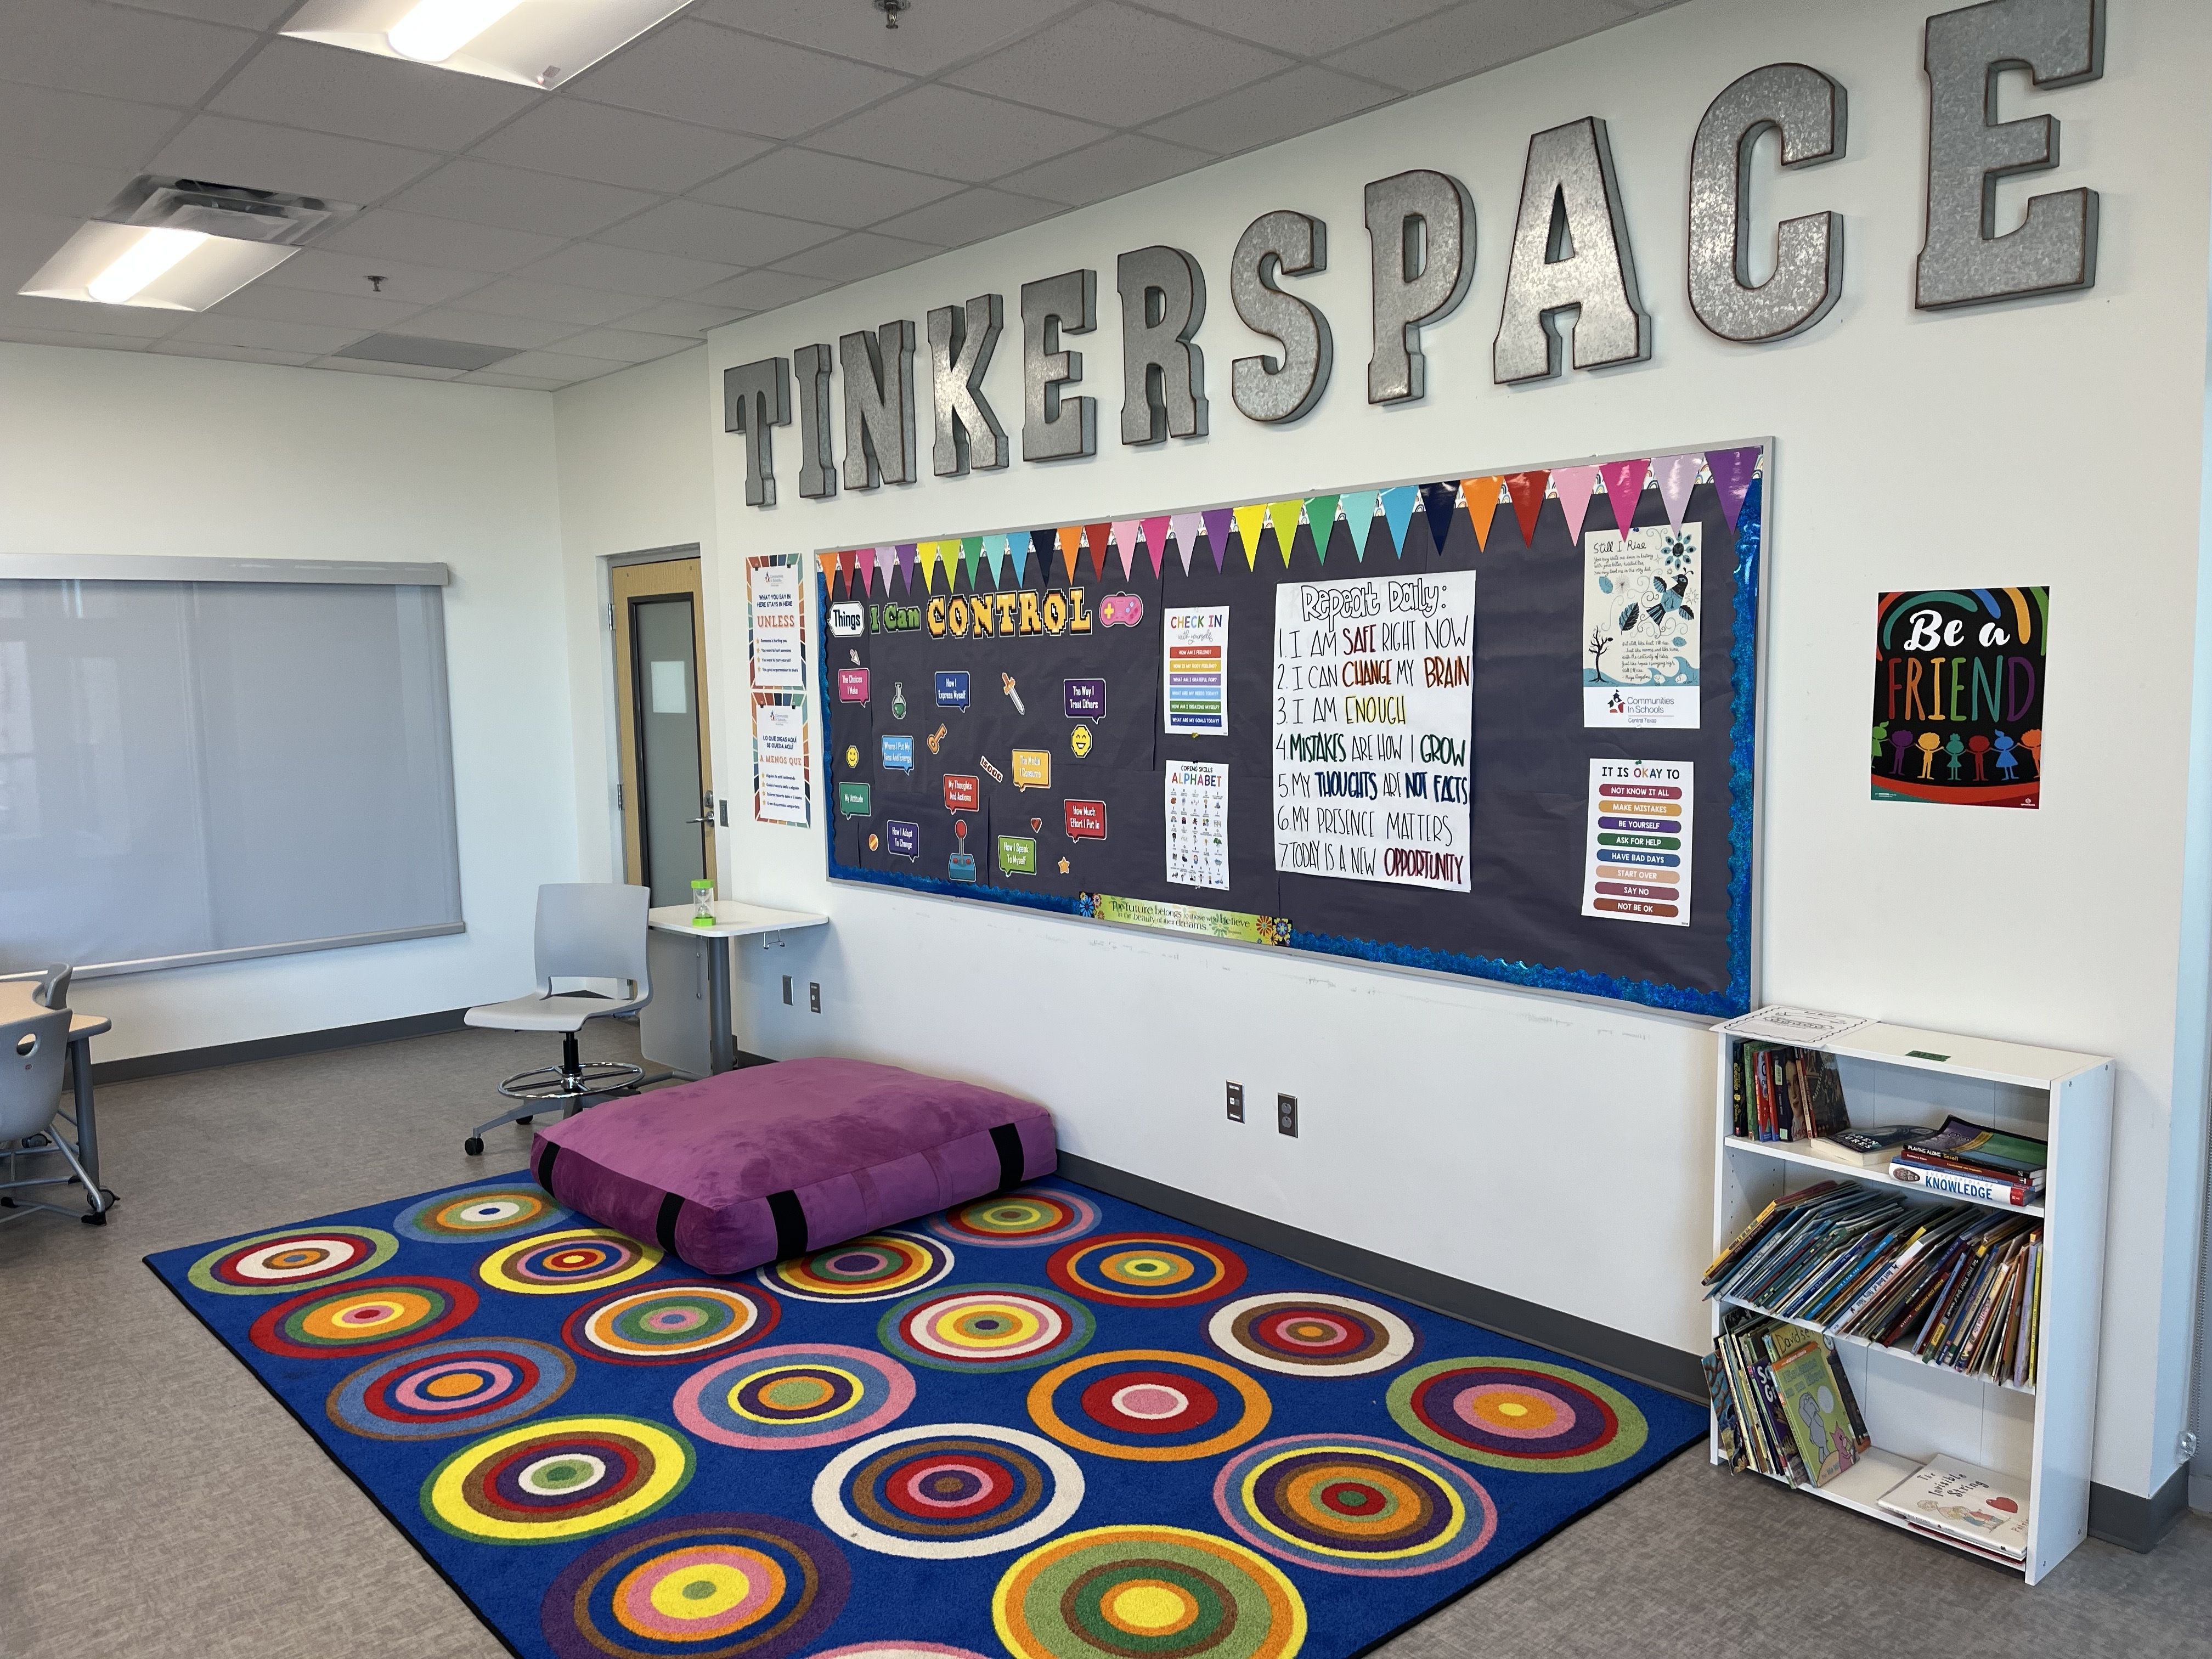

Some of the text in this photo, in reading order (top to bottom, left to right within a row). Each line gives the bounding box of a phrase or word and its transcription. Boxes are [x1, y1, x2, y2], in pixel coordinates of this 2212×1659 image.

[724, 0, 2106, 507] TINKERSPACE
[1594, 540, 1646, 554] Still I Rise
[1301, 578, 1447, 633] Repeat Daily:
[833, 587, 1092, 639] Things I Can CONTROL
[757, 615, 794, 627] UNLESS
[1171, 614, 1222, 628] CHECK IN
[1188, 629, 1213, 645] yourself
[1289, 630, 1302, 658] I
[1311, 630, 1336, 657] AM
[1343, 624, 1376, 655] SAFE
[1382, 620, 1416, 651] RIGHT
[1425, 615, 1469, 649] NOW
[1904, 610, 2010, 651] Be a
[1293, 666, 1304, 691] I
[1308, 664, 1338, 689] CAN
[1342, 659, 1392, 687] CHANGE
[1397, 659, 1414, 686] MY
[1424, 656, 1470, 688] BRAIN
[955, 678, 956, 687] I
[1888, 655, 2035, 722] FRIEND
[938, 690, 966, 701] Express Myself
[1073, 686, 1094, 697] The Way I
[1070, 699, 1098, 708] Treat Others
[1293, 698, 1304, 724] I
[1313, 697, 1337, 724] AM
[1346, 696, 1406, 724] ENOUGH
[1290, 732, 1346, 763] MISTAKES
[1352, 735, 1373, 761] ARE
[1378, 733, 1402, 761] HOW
[1411, 735, 1413, 763] I
[1420, 734, 1465, 767] GROW
[766, 755, 787, 764] MENOS
[1172, 772, 1221, 787] ALPHABET
[1602, 767, 1679, 779] IT IS OKAY TO
[1292, 772, 1310, 798] MY
[1314, 771, 1378, 800] THOUGHTS
[1383, 772, 1401, 797] ARE
[1405, 772, 1427, 799] NOT
[1434, 775, 1468, 805] FACTS
[1073, 806, 1095, 816] How Much
[1634, 805, 1667, 813] MISTAKES
[1070, 818, 1082, 827] Effort
[1084, 819, 1085, 828] I
[1095, 820, 1100, 830] In
[1293, 806, 1309, 832] MY
[1317, 808, 1375, 837] PRESENCE
[1387, 812, 1452, 846] MATTERS
[1629, 821, 1660, 830] YOURSELF
[1004, 842, 1013, 851] How
[1016, 843, 1029, 853] Speak
[1007, 854, 1026, 866] To Myself
[1290, 840, 1320, 871] TODAY
[1325, 843, 1334, 870] IS
[1340, 845, 1346, 872] A
[1351, 847, 1376, 876] NEW
[1384, 848, 1463, 884] OPPORTUNITY
[1647, 855, 1664, 864] DAYS
[1639, 887, 1649, 895] NO
[1125, 902, 1153, 915] future
[1155, 905, 1182, 918] belongs
[1133, 913, 1155, 926] beauty
[1908, 1146, 1926, 1155] PLAYING
[1926, 1171, 1979, 1186] ENCYCLOPEDIA
[1926, 1176, 1993, 1200] KNOWLEDGE
[1928, 1472, 1967, 1497] Invisible
[1947, 1480, 1989, 1497] String
